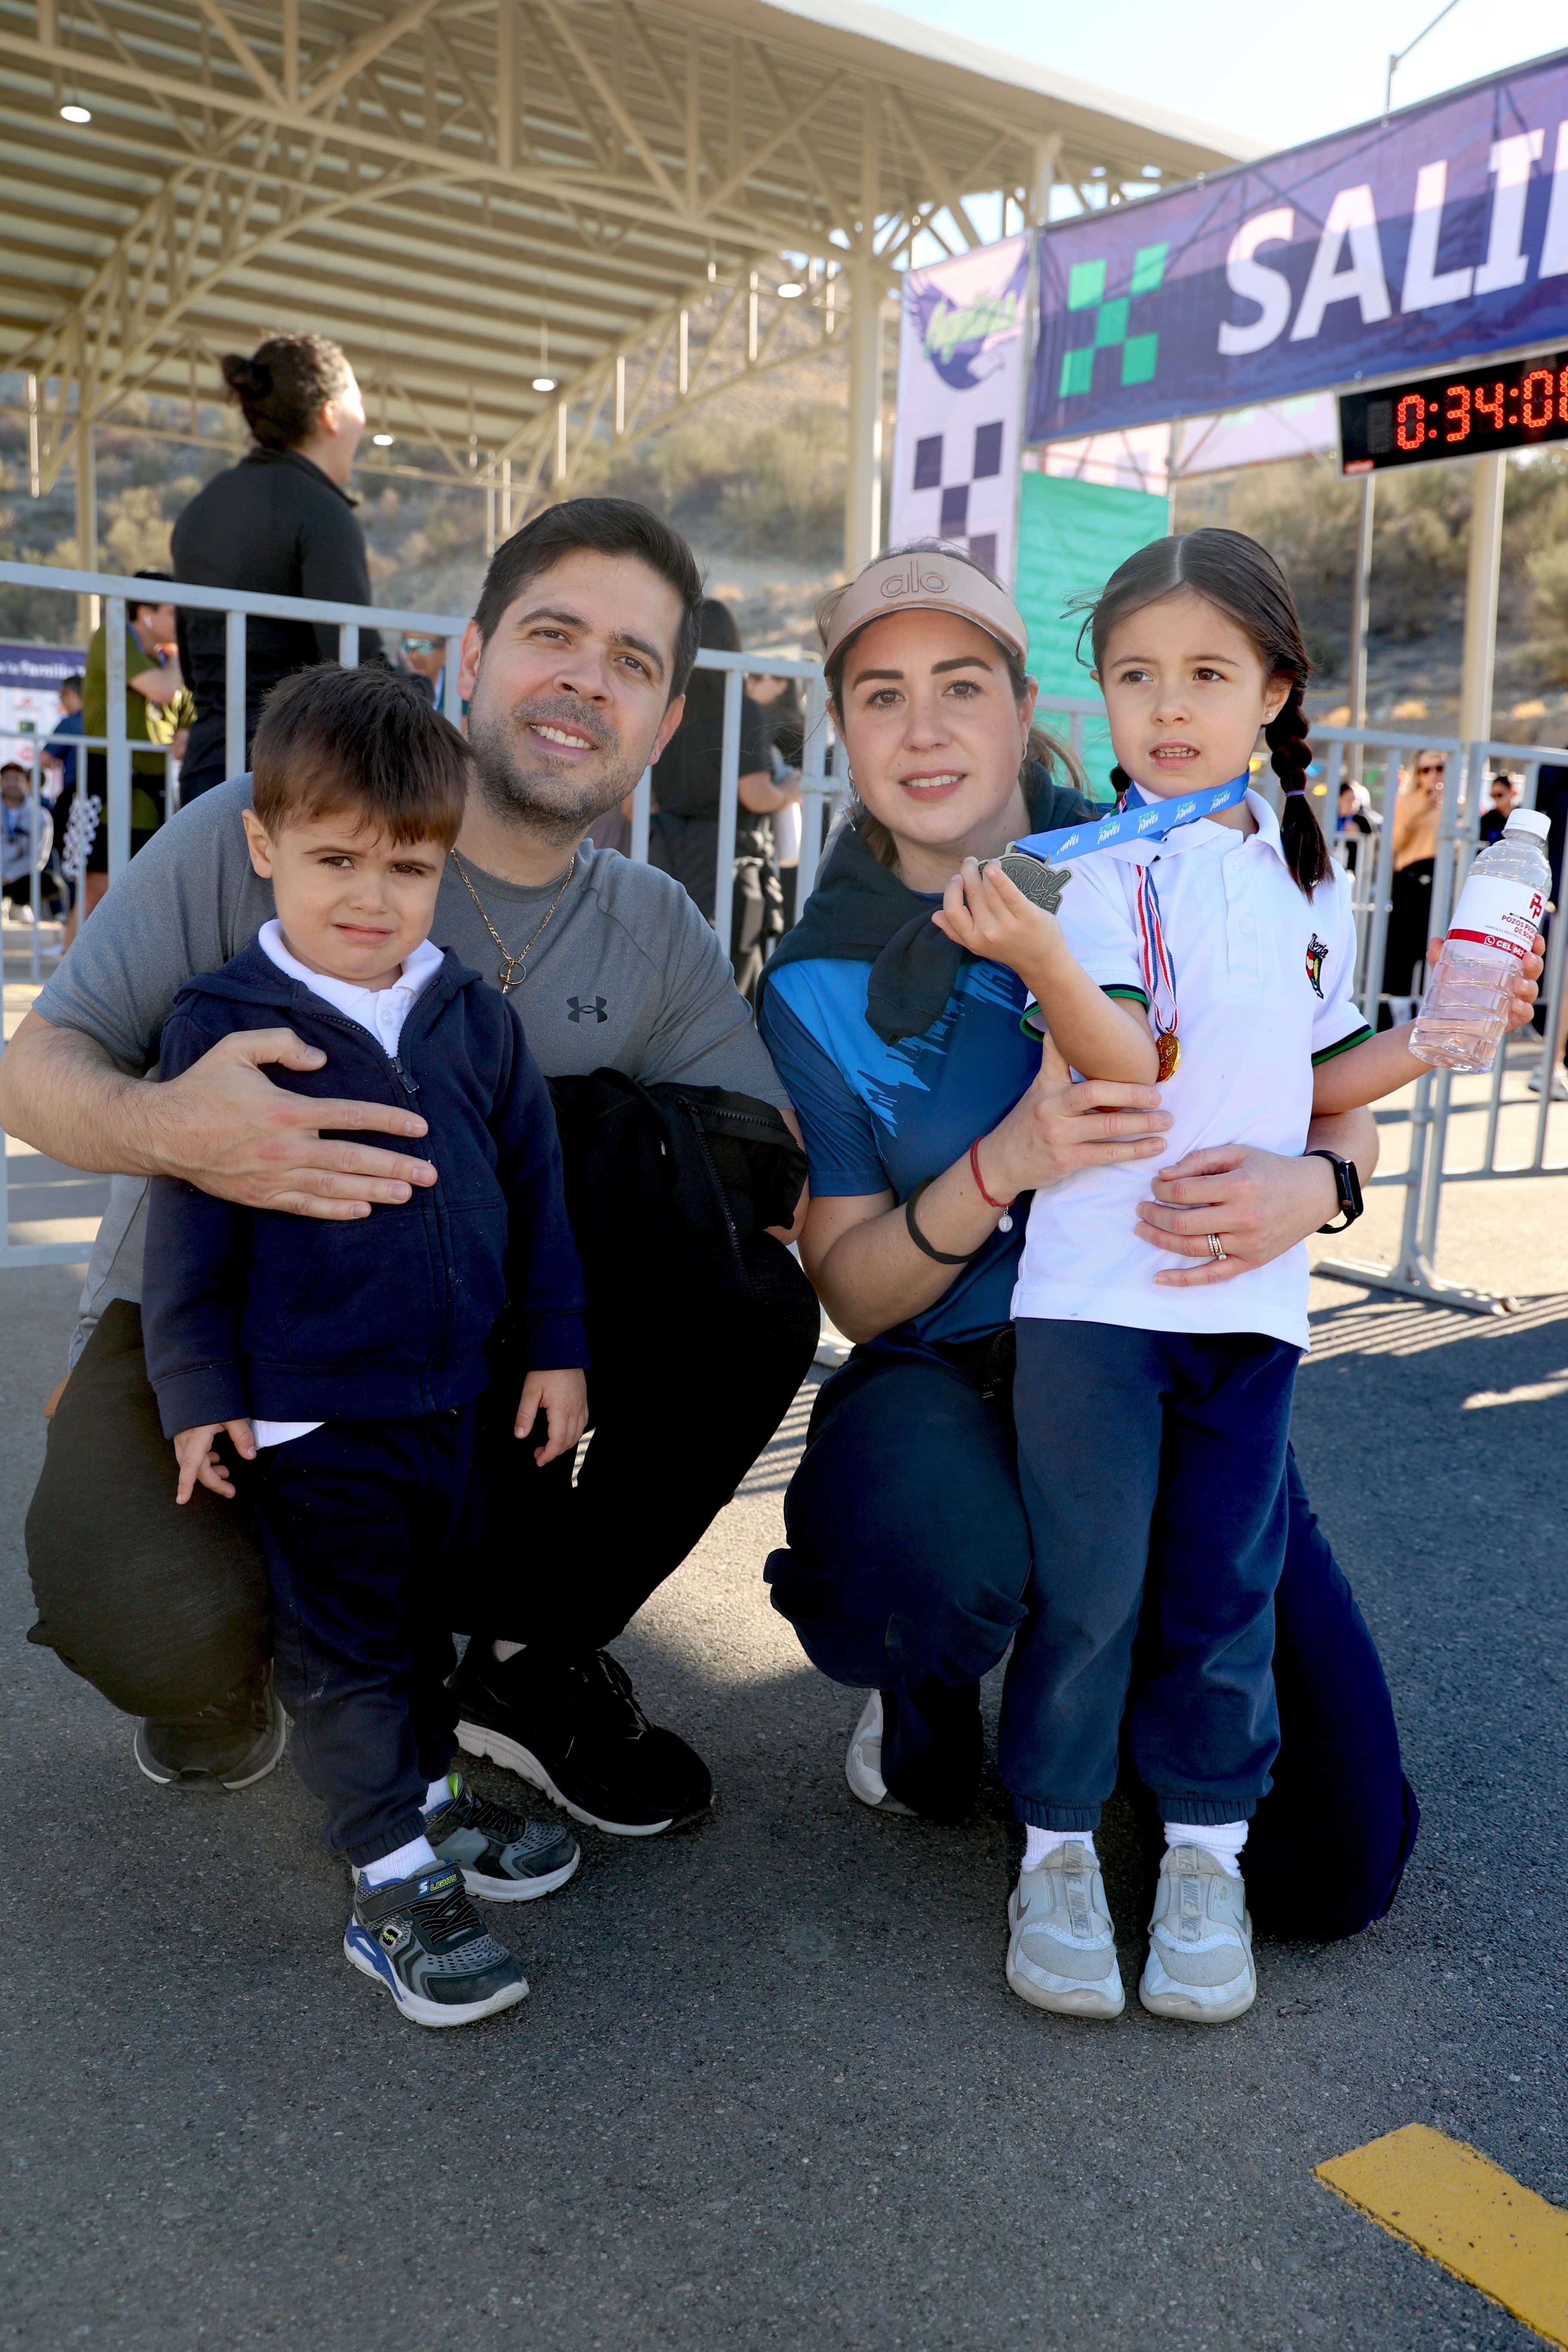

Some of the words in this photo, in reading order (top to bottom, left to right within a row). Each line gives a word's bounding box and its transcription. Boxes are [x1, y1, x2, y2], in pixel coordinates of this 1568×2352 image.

[880, 560, 949, 597] alo
[1210, 792, 1230, 812] FAMILY
[1213, 790, 1228, 800] RACE
[1174, 802, 1196, 823] FAMILY
[1177, 800, 1193, 812] RACE
[1138, 812, 1158, 833] FAMILY
[1139, 810, 1155, 822] RACE
[1097, 823, 1120, 845] FAMILY
[1099, 820, 1117, 833] RACE
[980, 866, 1069, 900] MILY
[1501, 915, 1525, 928] POZOS
[1524, 924, 1536, 935] PROF
[1514, 927, 1522, 935] DE
[1496, 940, 1512, 951] CEL
[1513, 946, 1526, 957] 662
[430, 1868, 455, 1883] SPORT
[430, 1874, 457, 1892] LIGHTS
[1183, 1880, 1198, 1911] NIKE
